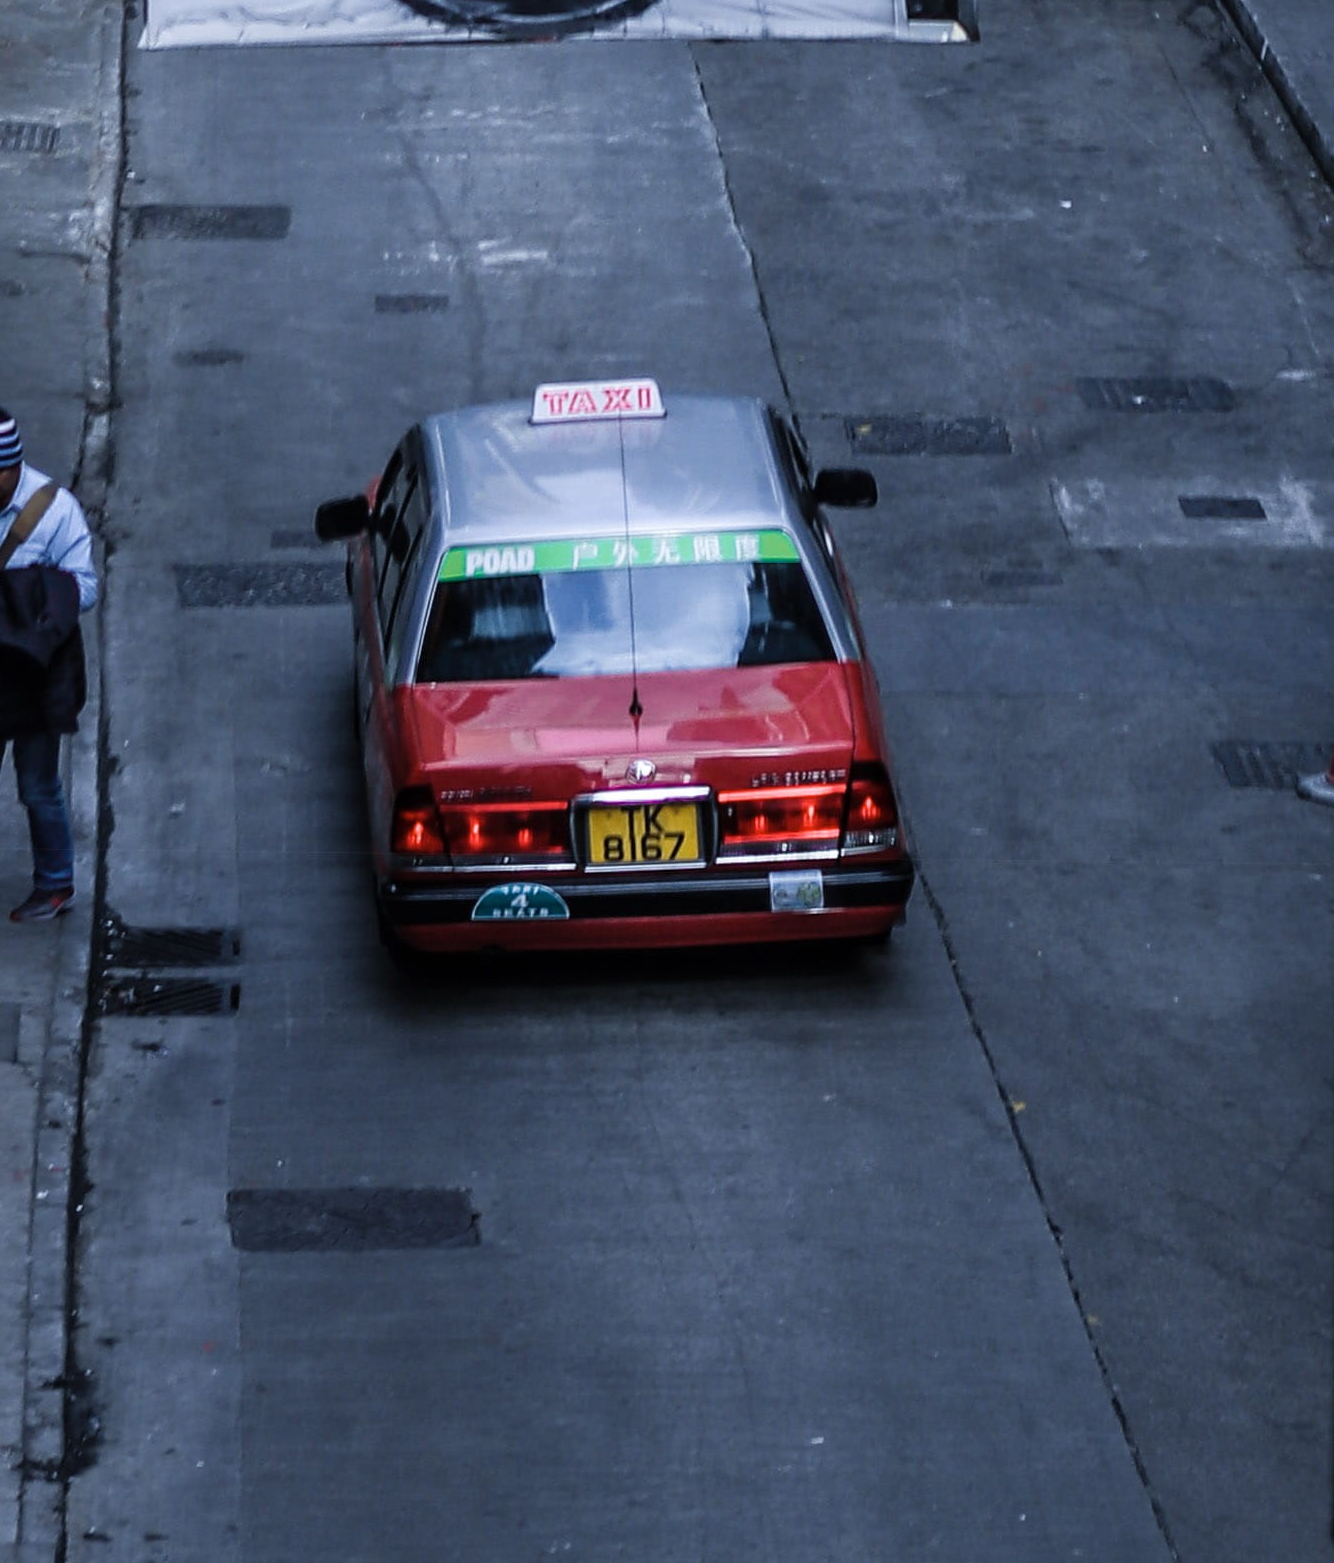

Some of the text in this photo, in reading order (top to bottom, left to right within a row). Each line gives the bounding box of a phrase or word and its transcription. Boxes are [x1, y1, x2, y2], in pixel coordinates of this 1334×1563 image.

[541, 385, 653, 416] TAXI
[465, 547, 536, 576] POAD
[602, 831, 687, 864] 8167
[510, 895, 530, 908] 4
